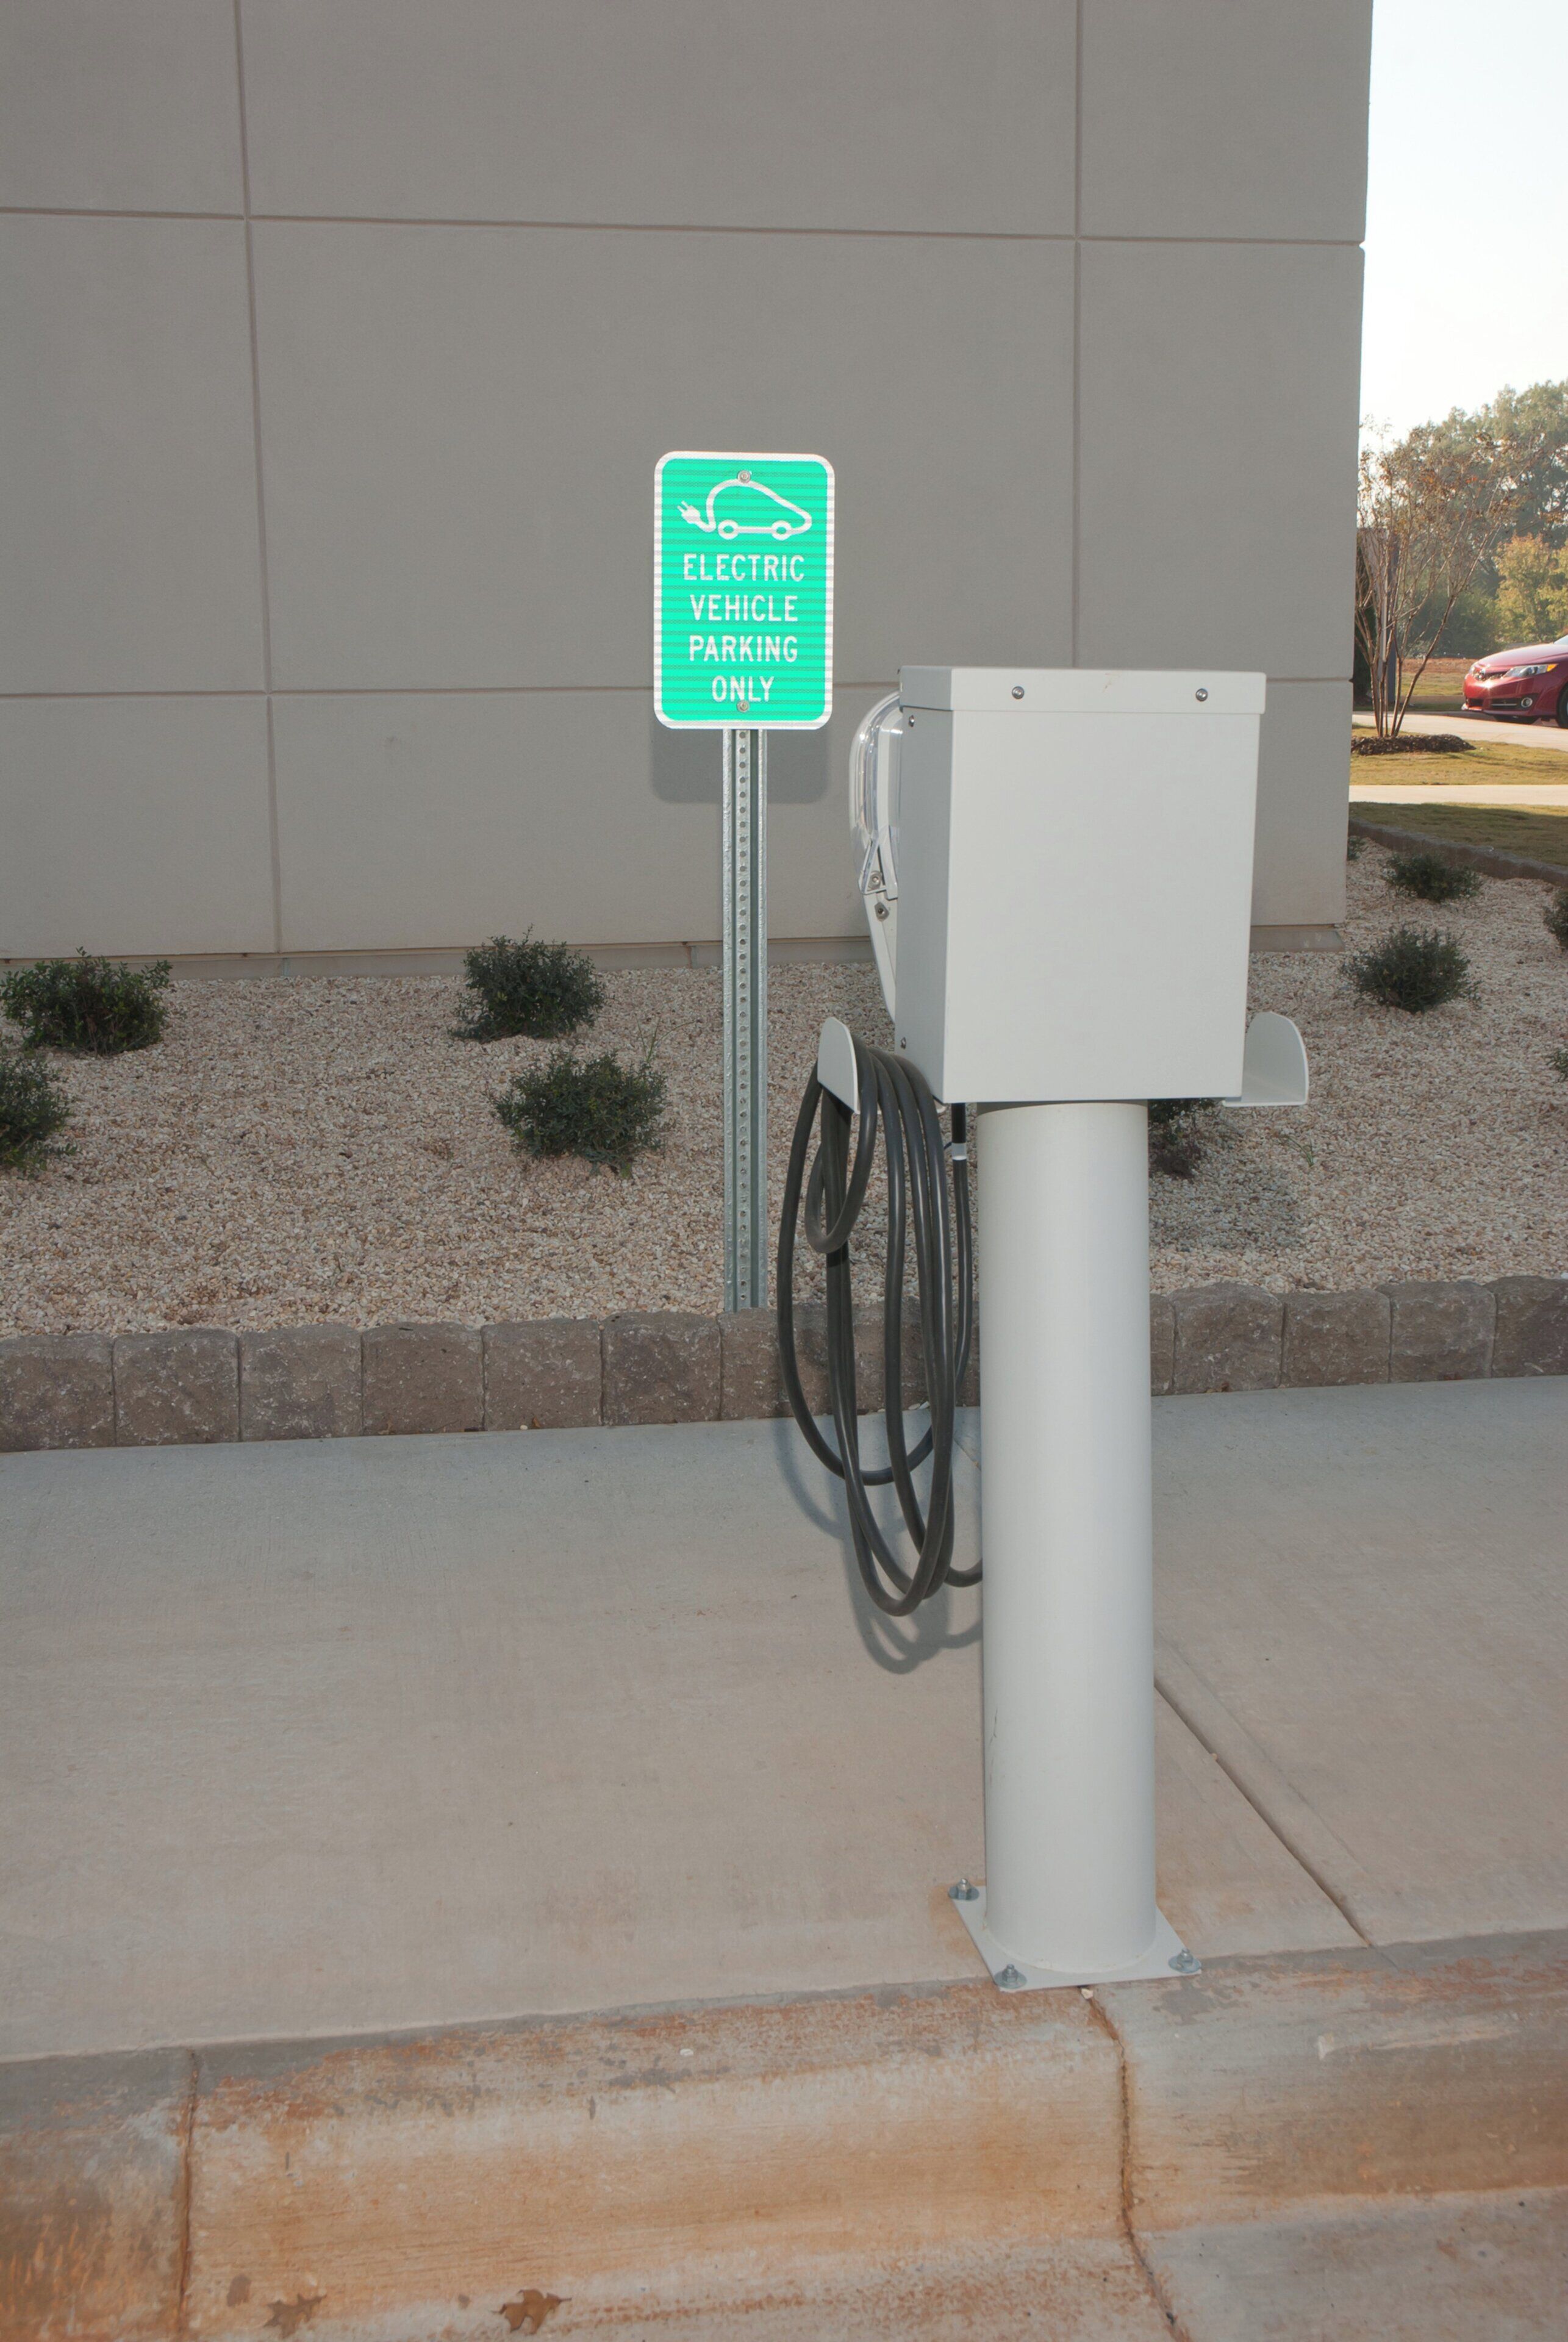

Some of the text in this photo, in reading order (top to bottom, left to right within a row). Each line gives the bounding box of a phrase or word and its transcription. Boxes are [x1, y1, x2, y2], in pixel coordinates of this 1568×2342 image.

[683, 554, 804, 581] ELECTRIC
[690, 595, 798, 621] VEHICLE
[689, 636, 798, 662] PARKING
[712, 675, 774, 702] ONLY
